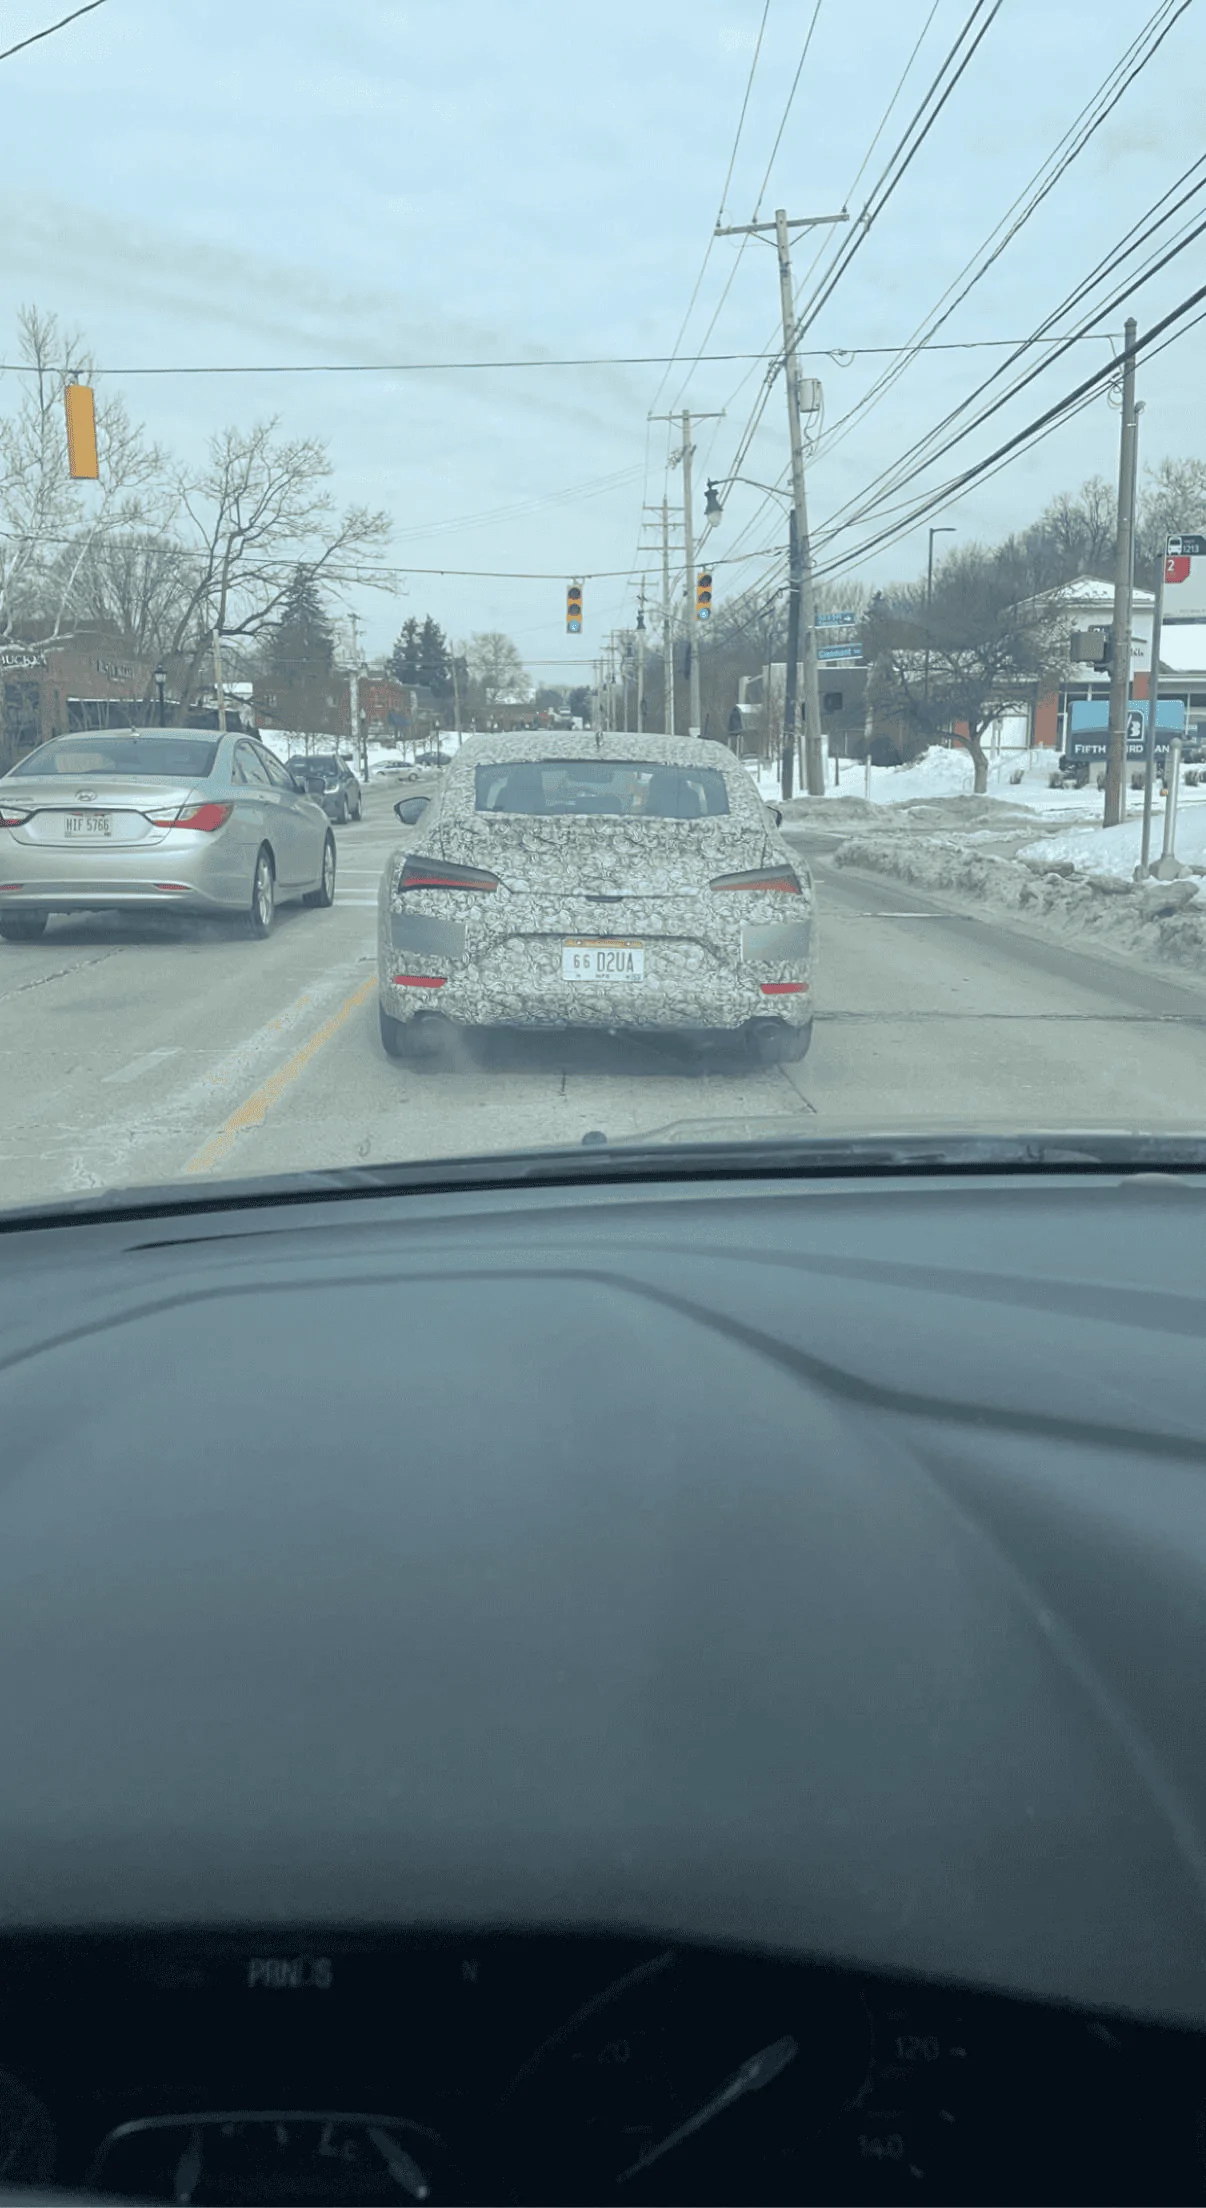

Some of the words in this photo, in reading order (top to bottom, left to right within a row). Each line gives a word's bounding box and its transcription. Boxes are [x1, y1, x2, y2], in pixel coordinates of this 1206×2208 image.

[1183, 545, 1200, 553] 1213
[1167, 559, 1175, 571] 2
[1074, 744, 1107, 754] FIFTH
[66, 818, 82, 831] HIF
[86, 818, 110, 831] 5766
[573, 954, 591, 969] 66
